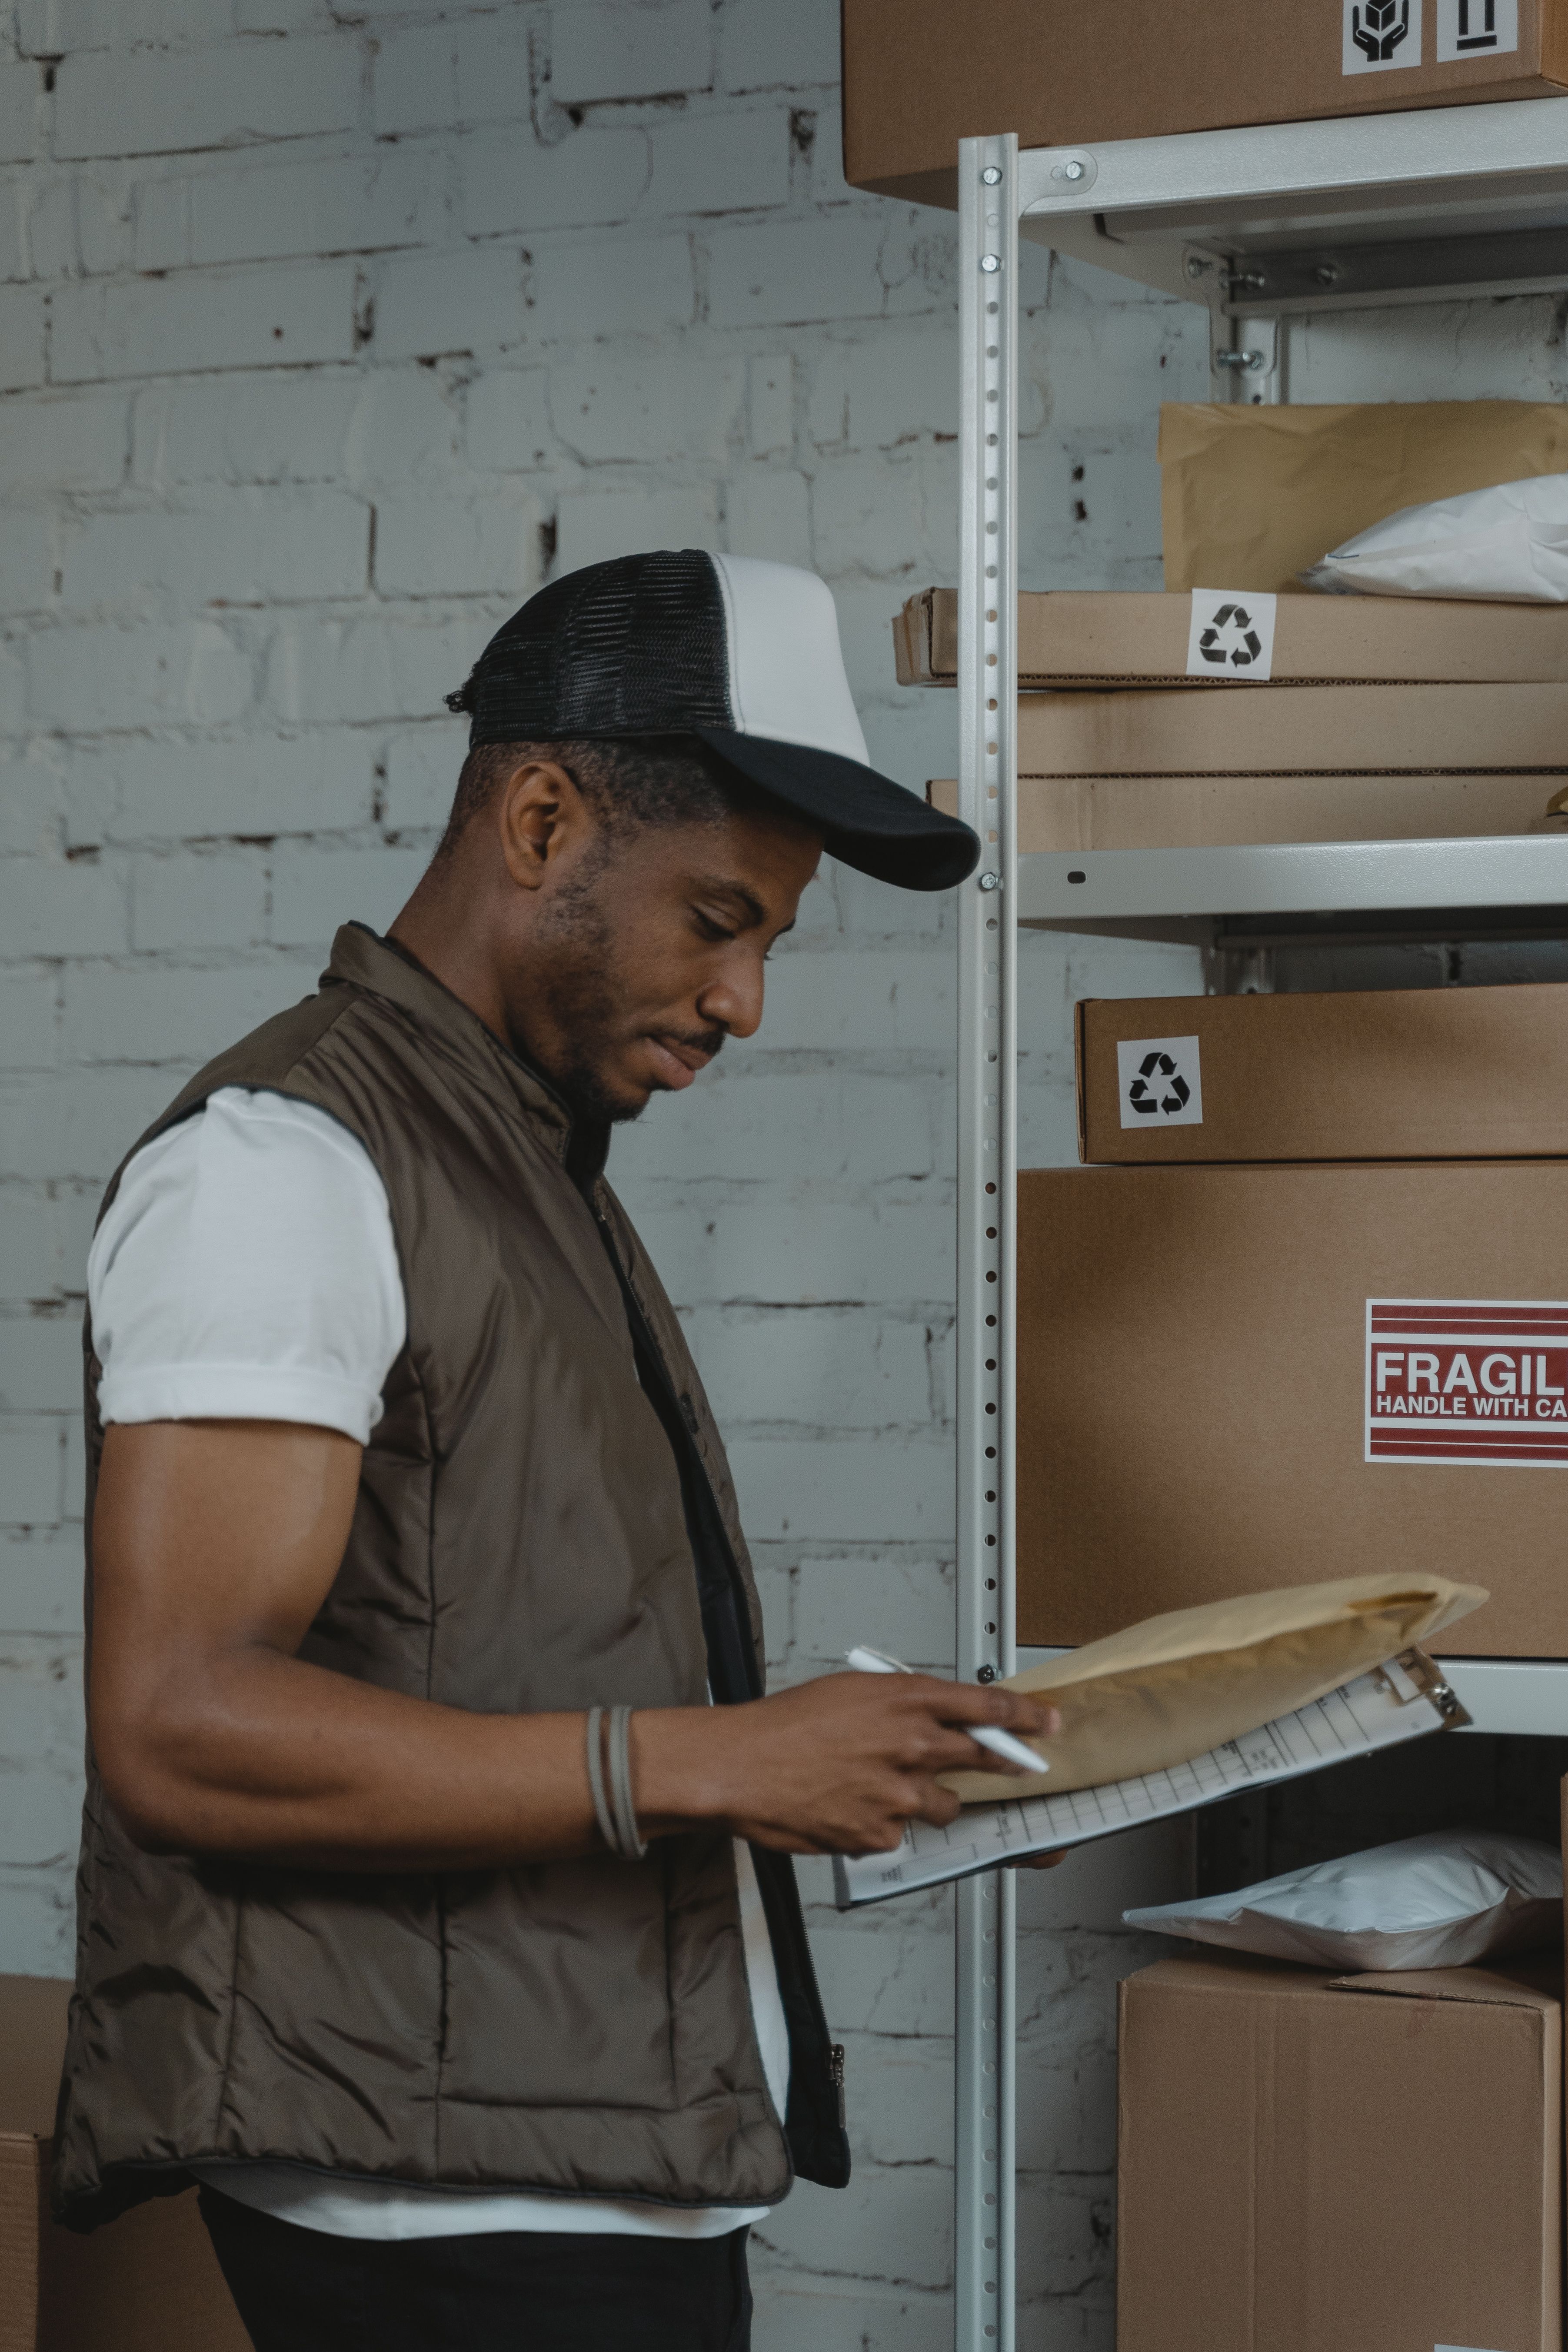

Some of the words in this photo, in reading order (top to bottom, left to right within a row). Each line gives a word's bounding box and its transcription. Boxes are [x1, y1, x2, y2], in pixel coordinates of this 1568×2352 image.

[1377, 1352, 1565, 1396] FRAGIL
[1377, 1396, 1467, 1415] HANDLE
[1473, 1398, 1529, 1416] WITH
[1535, 1399, 1568, 1417] CA
